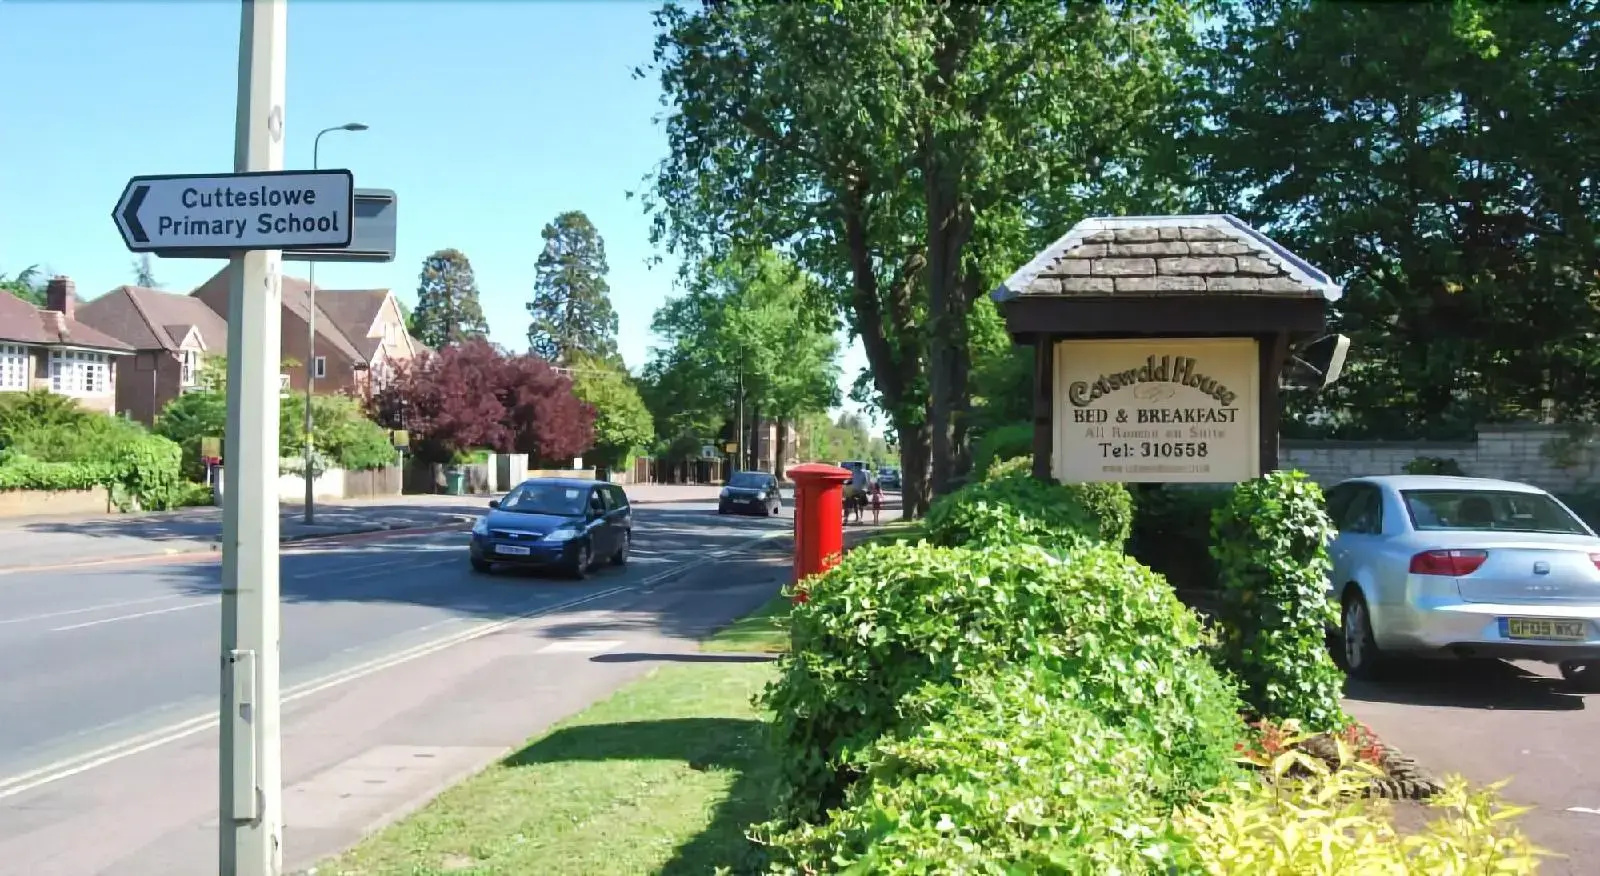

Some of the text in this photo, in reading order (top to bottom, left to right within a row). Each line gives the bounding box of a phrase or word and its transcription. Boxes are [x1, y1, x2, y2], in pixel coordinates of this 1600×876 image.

[181, 186, 316, 208] Cutteslowe
[158, 211, 339, 238] Primary School
[1068, 354, 1238, 407] Cotswold House
[1073, 407, 1239, 424] BED & BREAKFAST
[1097, 442, 1209, 458] Tel: 310558
